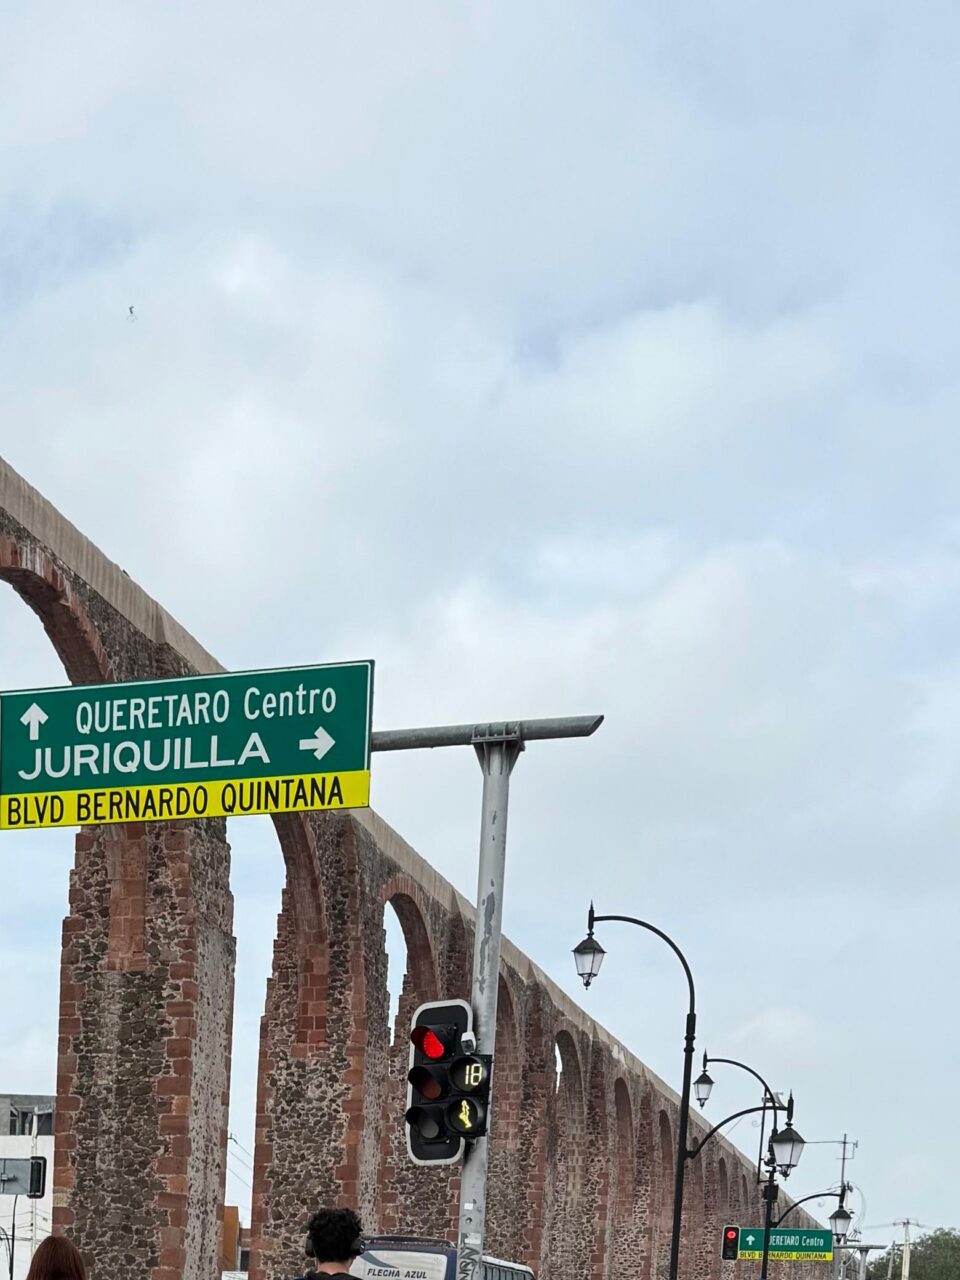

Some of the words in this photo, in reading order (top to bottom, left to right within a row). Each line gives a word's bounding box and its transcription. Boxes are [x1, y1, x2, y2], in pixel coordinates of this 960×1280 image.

[76, 690, 230, 734] QUERETARO
[244, 683, 337, 720] Centro
[18, 732, 270, 781] JURIQUILLA
[7, 795, 65, 826] BLVD
[77, 785, 209, 821] BERNARDO
[221, 775, 345, 814] QUINTANA
[465, 1063, 483, 1086] 18
[768, 1235, 800, 1246] UERETARO
[801, 1236, 824, 1247] Centro
[740, 1251, 756, 1259] BLVD
[758, 1251, 793, 1259] BRNARDO
[795, 1252, 827, 1260] QUINTANA
[367, 1268, 400, 1278] FLECHA
[404, 1271, 427, 1279] AZUL
